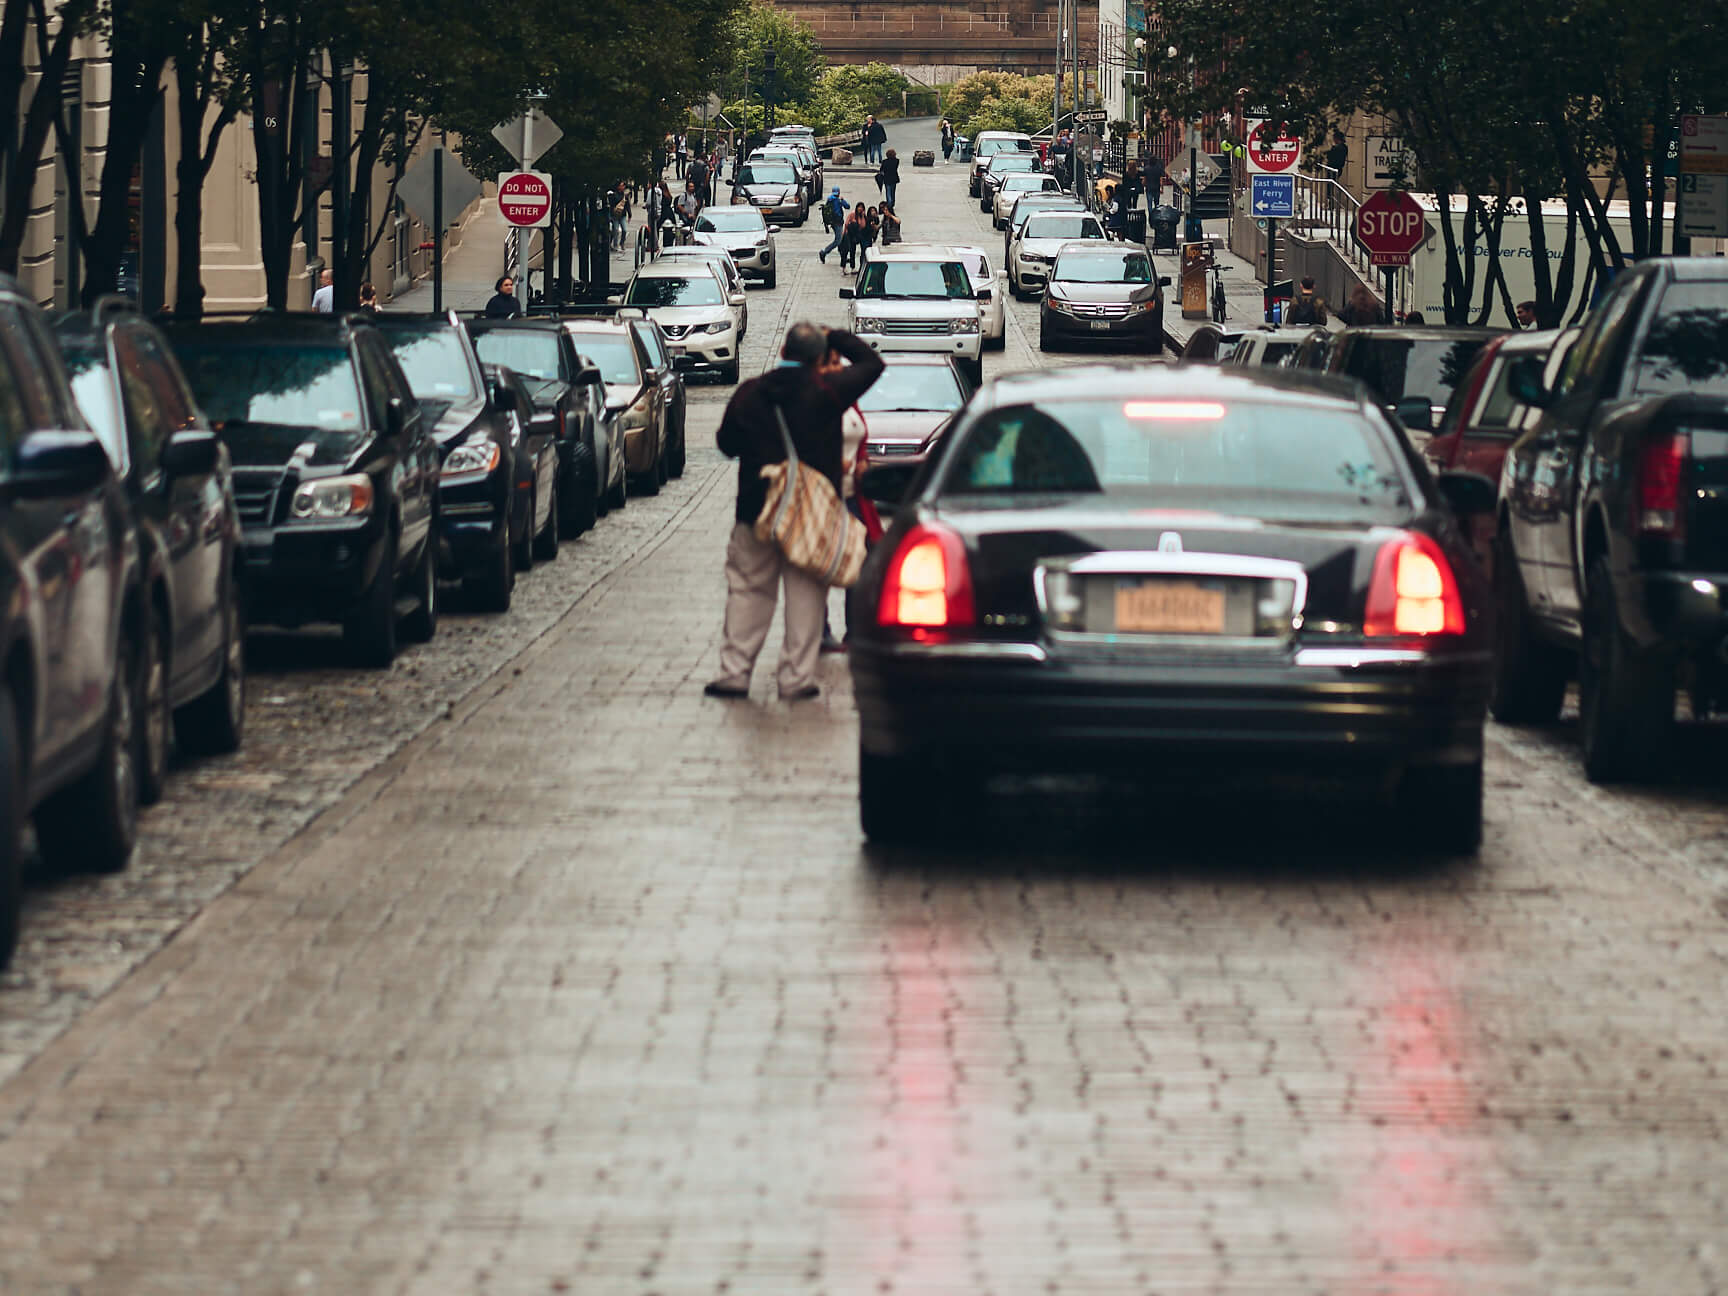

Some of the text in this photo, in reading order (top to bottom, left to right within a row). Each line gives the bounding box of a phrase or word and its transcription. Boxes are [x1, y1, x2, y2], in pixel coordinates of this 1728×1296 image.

[1379, 140, 1406, 152] ALL
[1258, 153, 1288, 162] ENTER
[507, 184, 543, 192] DO NOT
[1262, 190, 1283, 198] Ferry
[510, 207, 538, 215] ENTER
[1362, 211, 1419, 235] STOP
[1373, 255, 1407, 263] ALL WAY
